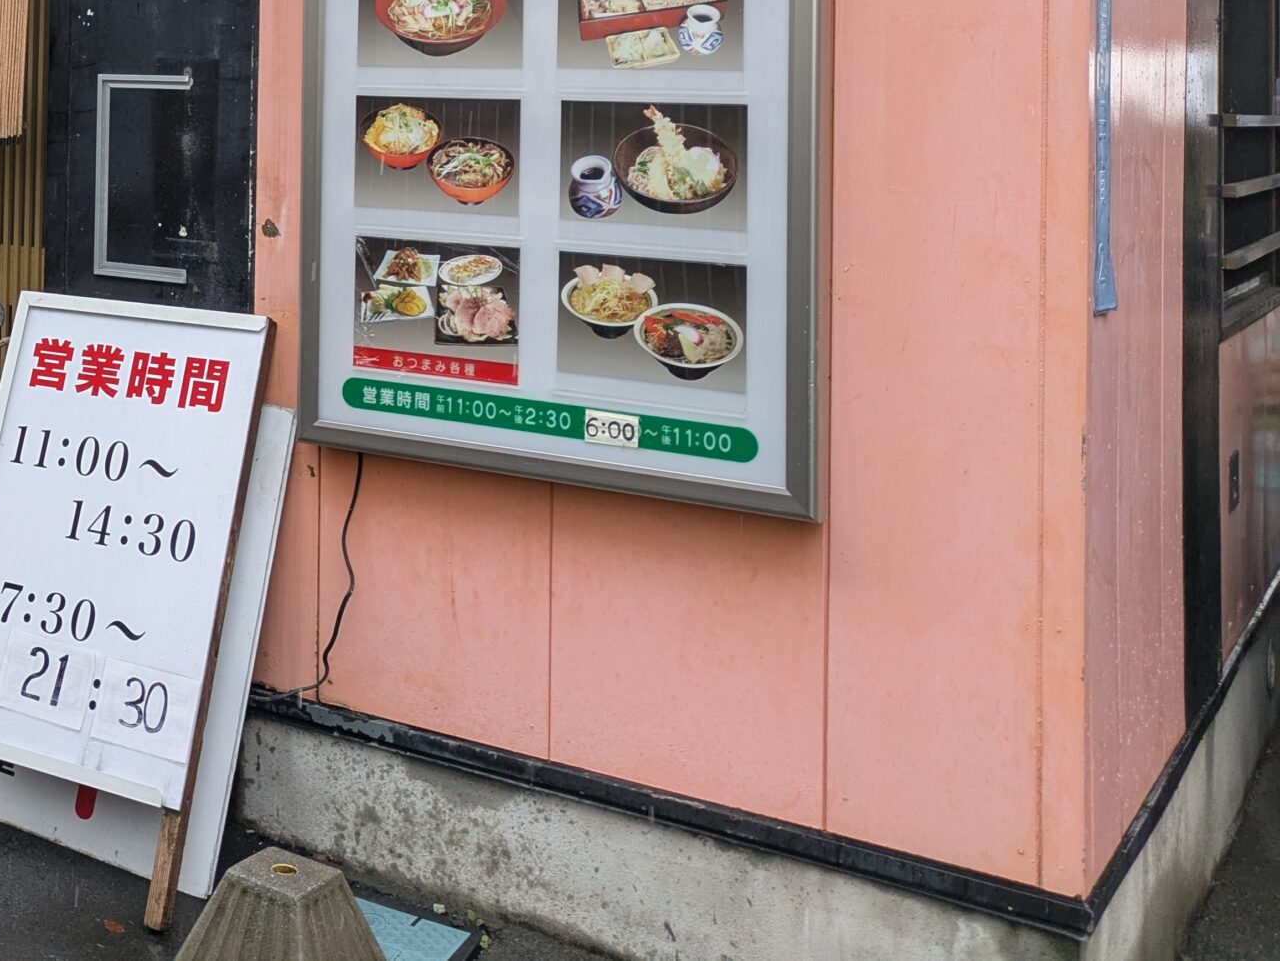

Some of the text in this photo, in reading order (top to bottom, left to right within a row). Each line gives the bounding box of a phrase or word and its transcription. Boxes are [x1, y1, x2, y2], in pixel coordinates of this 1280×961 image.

[28, 338, 230, 413] 営業時間
[393, 355, 475, 377] おつまみ各種
[362, 385, 430, 412] 営業時間
[65, 499, 197, 563] 14:30
